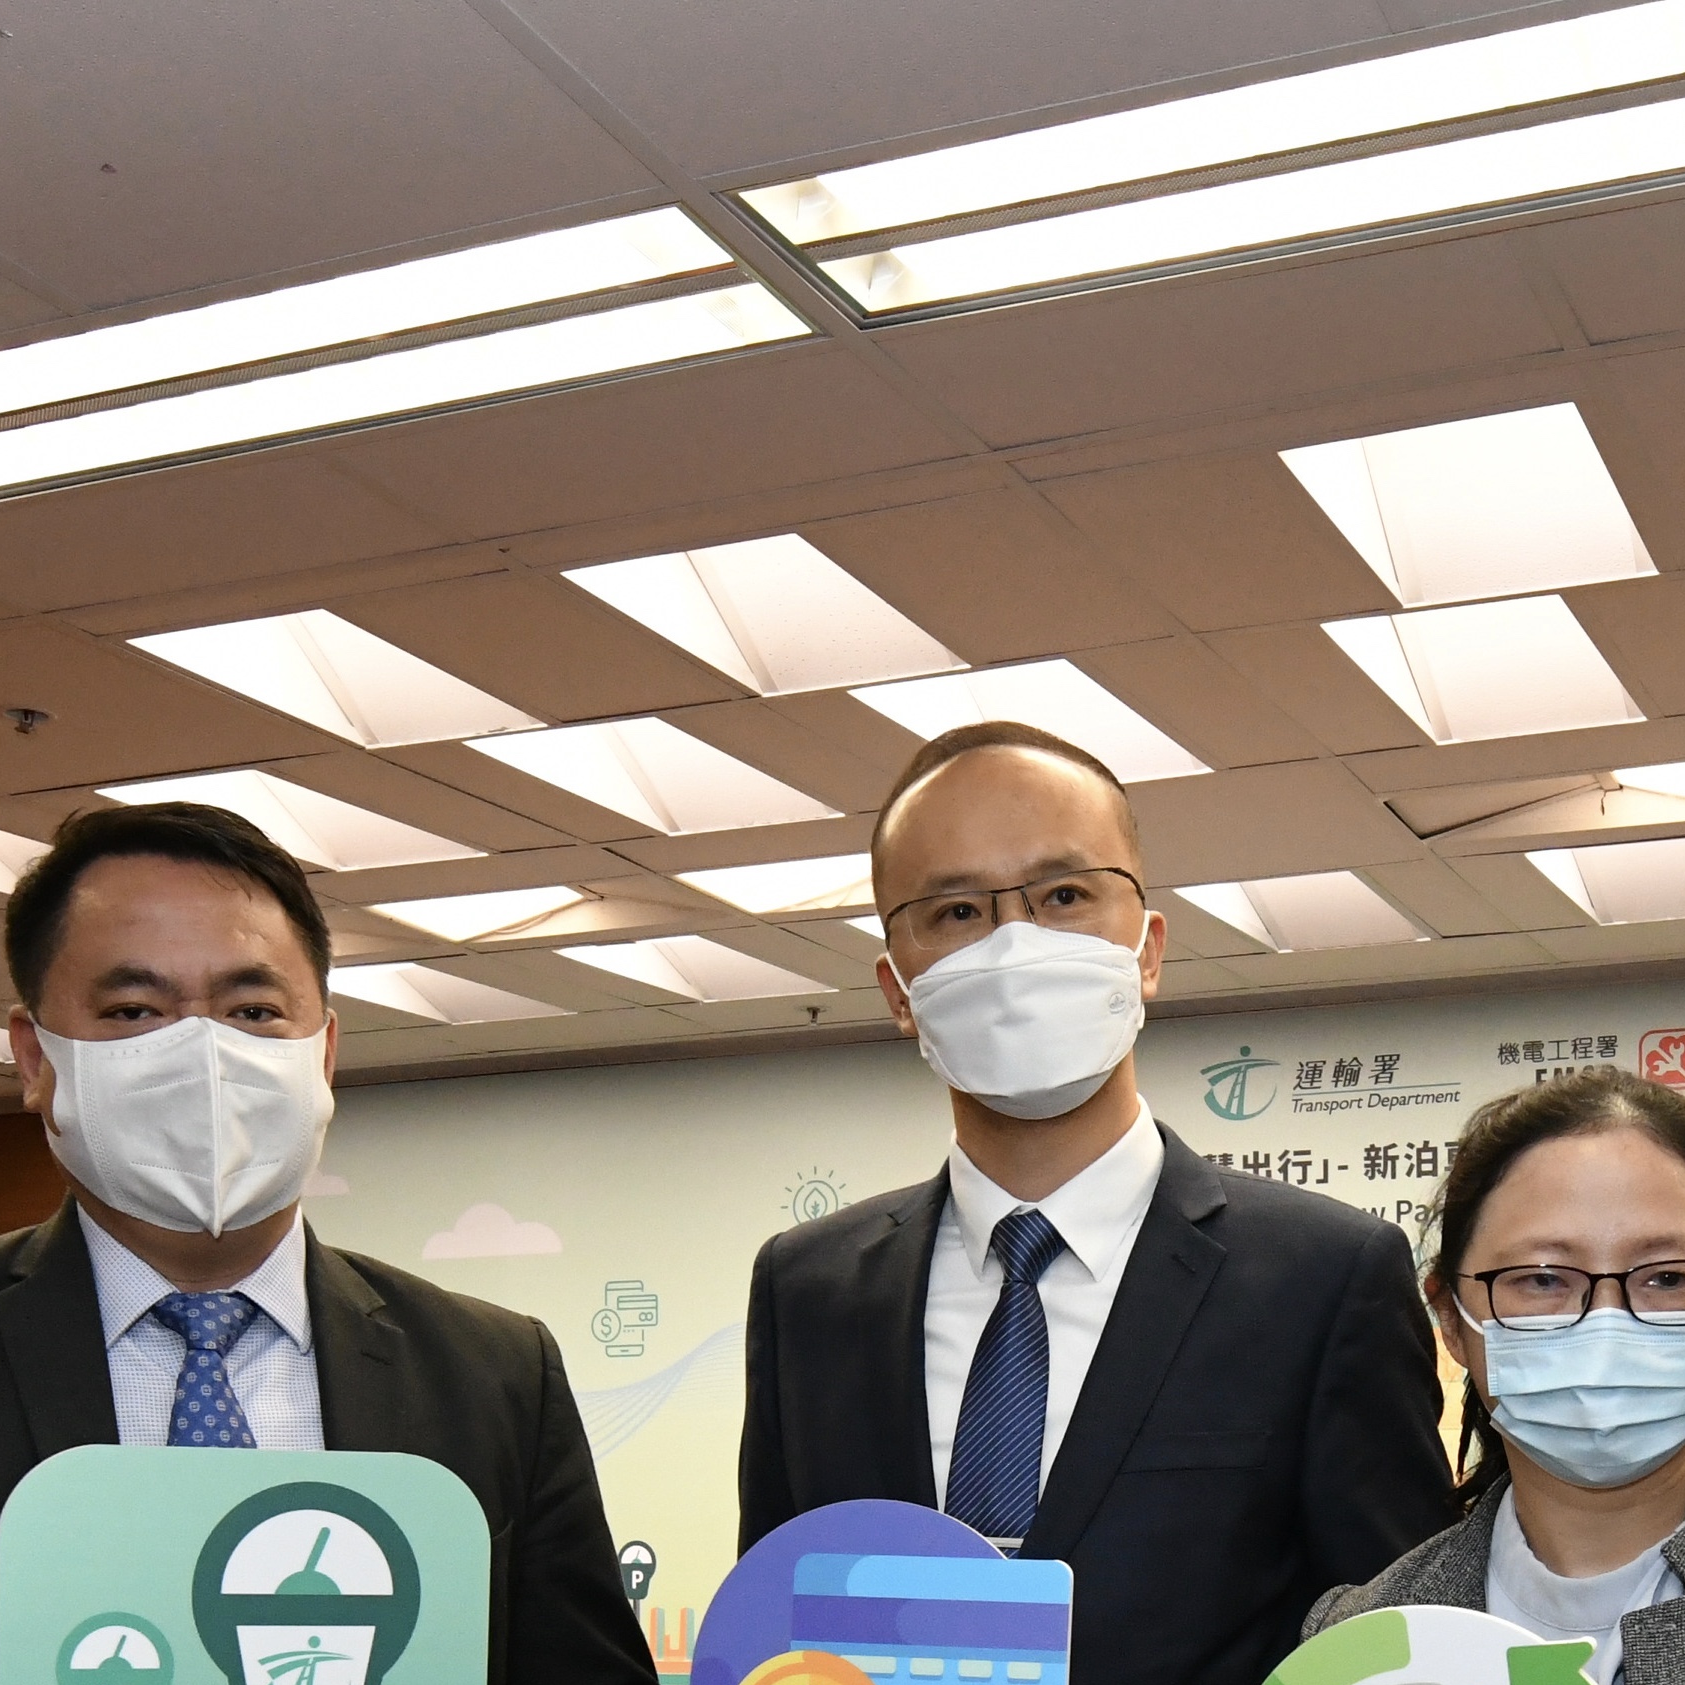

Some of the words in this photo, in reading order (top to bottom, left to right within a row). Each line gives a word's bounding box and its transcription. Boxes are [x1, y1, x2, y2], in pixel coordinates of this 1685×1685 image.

[1497, 1035, 1619, 1066] 機電工程署
[1295, 1053, 1401, 1092] 運輸署
[1291, 1095, 1365, 1116] Transport
[1367, 1089, 1461, 1113] Department
[631, 1570, 644, 1590] P
